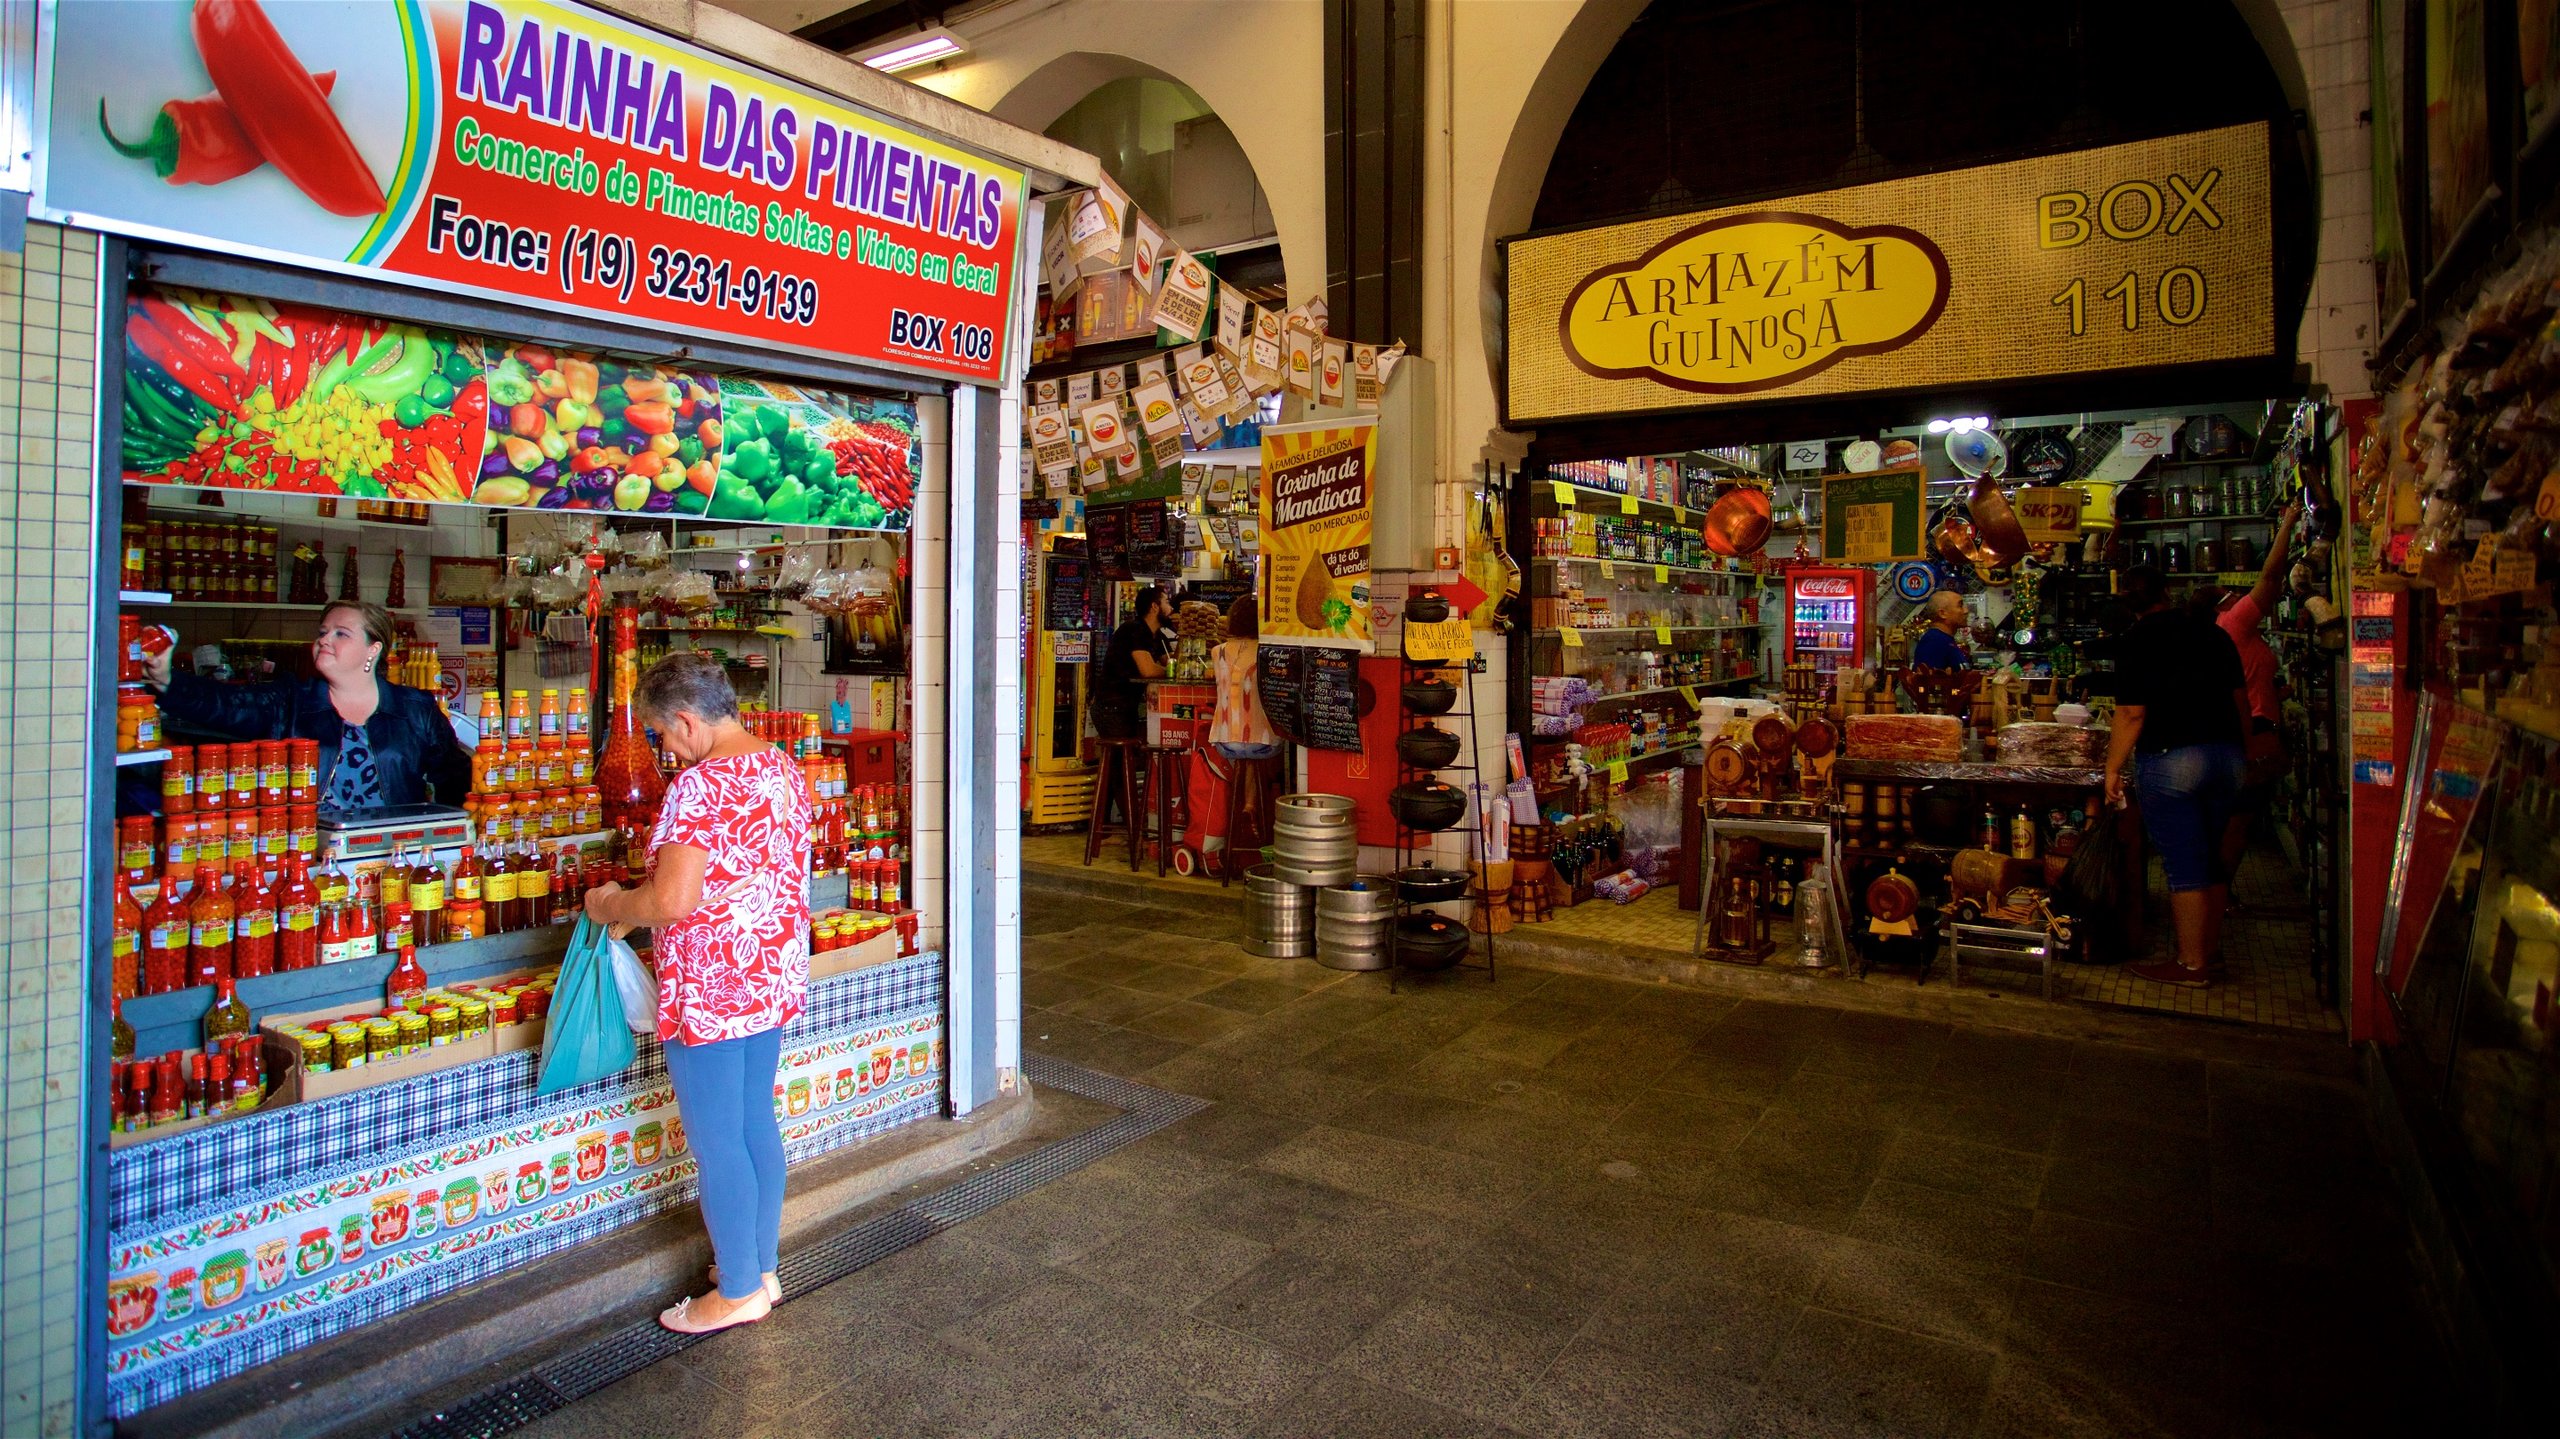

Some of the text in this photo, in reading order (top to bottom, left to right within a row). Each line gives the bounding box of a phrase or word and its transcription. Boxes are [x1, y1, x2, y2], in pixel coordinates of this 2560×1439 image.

[460, 1, 1002, 249] RAINHA DAS PIMENTAS
[455, 117, 998, 296] Comercio de Pimentas Soltas e Vidros em Geral
[1597, 169, 2224, 323] ARMAZÉM BOX
[430, 197, 819, 326] Fone: (19) 3231-9139
[1167, 288, 1202, 312] EM ABRIL
[1170, 299, 1183, 312] DE
[1184, 304, 1200, 320] LEI!
[1160, 304, 1198, 328] 14/4 A 7/5
[1648, 265, 2208, 371] GUINOSA 110
[890, 309, 993, 361] BOX 108
[1275, 453, 1306, 470] FAMOSA
[1307, 452, 1312, 461] E
[1313, 438, 1353, 460] DELICIOSA
[1276, 456, 1359, 498] Coxinha de
[1276, 484, 1362, 526] Mandioca
[2020, 503, 2074, 519] SKOL
[1309, 510, 1370, 534] DO MERCADÃO
[1328, 549, 1360, 565] dá té dó
[1334, 558, 1369, 576] di vendê!
[1800, 578, 1848, 594] Coca-Cola
[1275, 595, 1290, 603] Frango
[1275, 605, 1290, 614] Queijo
[1057, 645, 1088, 655] BRAHMA
[1447, 639, 1451, 649] E
[1162, 730, 1190, 739] 139 ANOS,
[1162, 738, 1182, 746] AGORA
